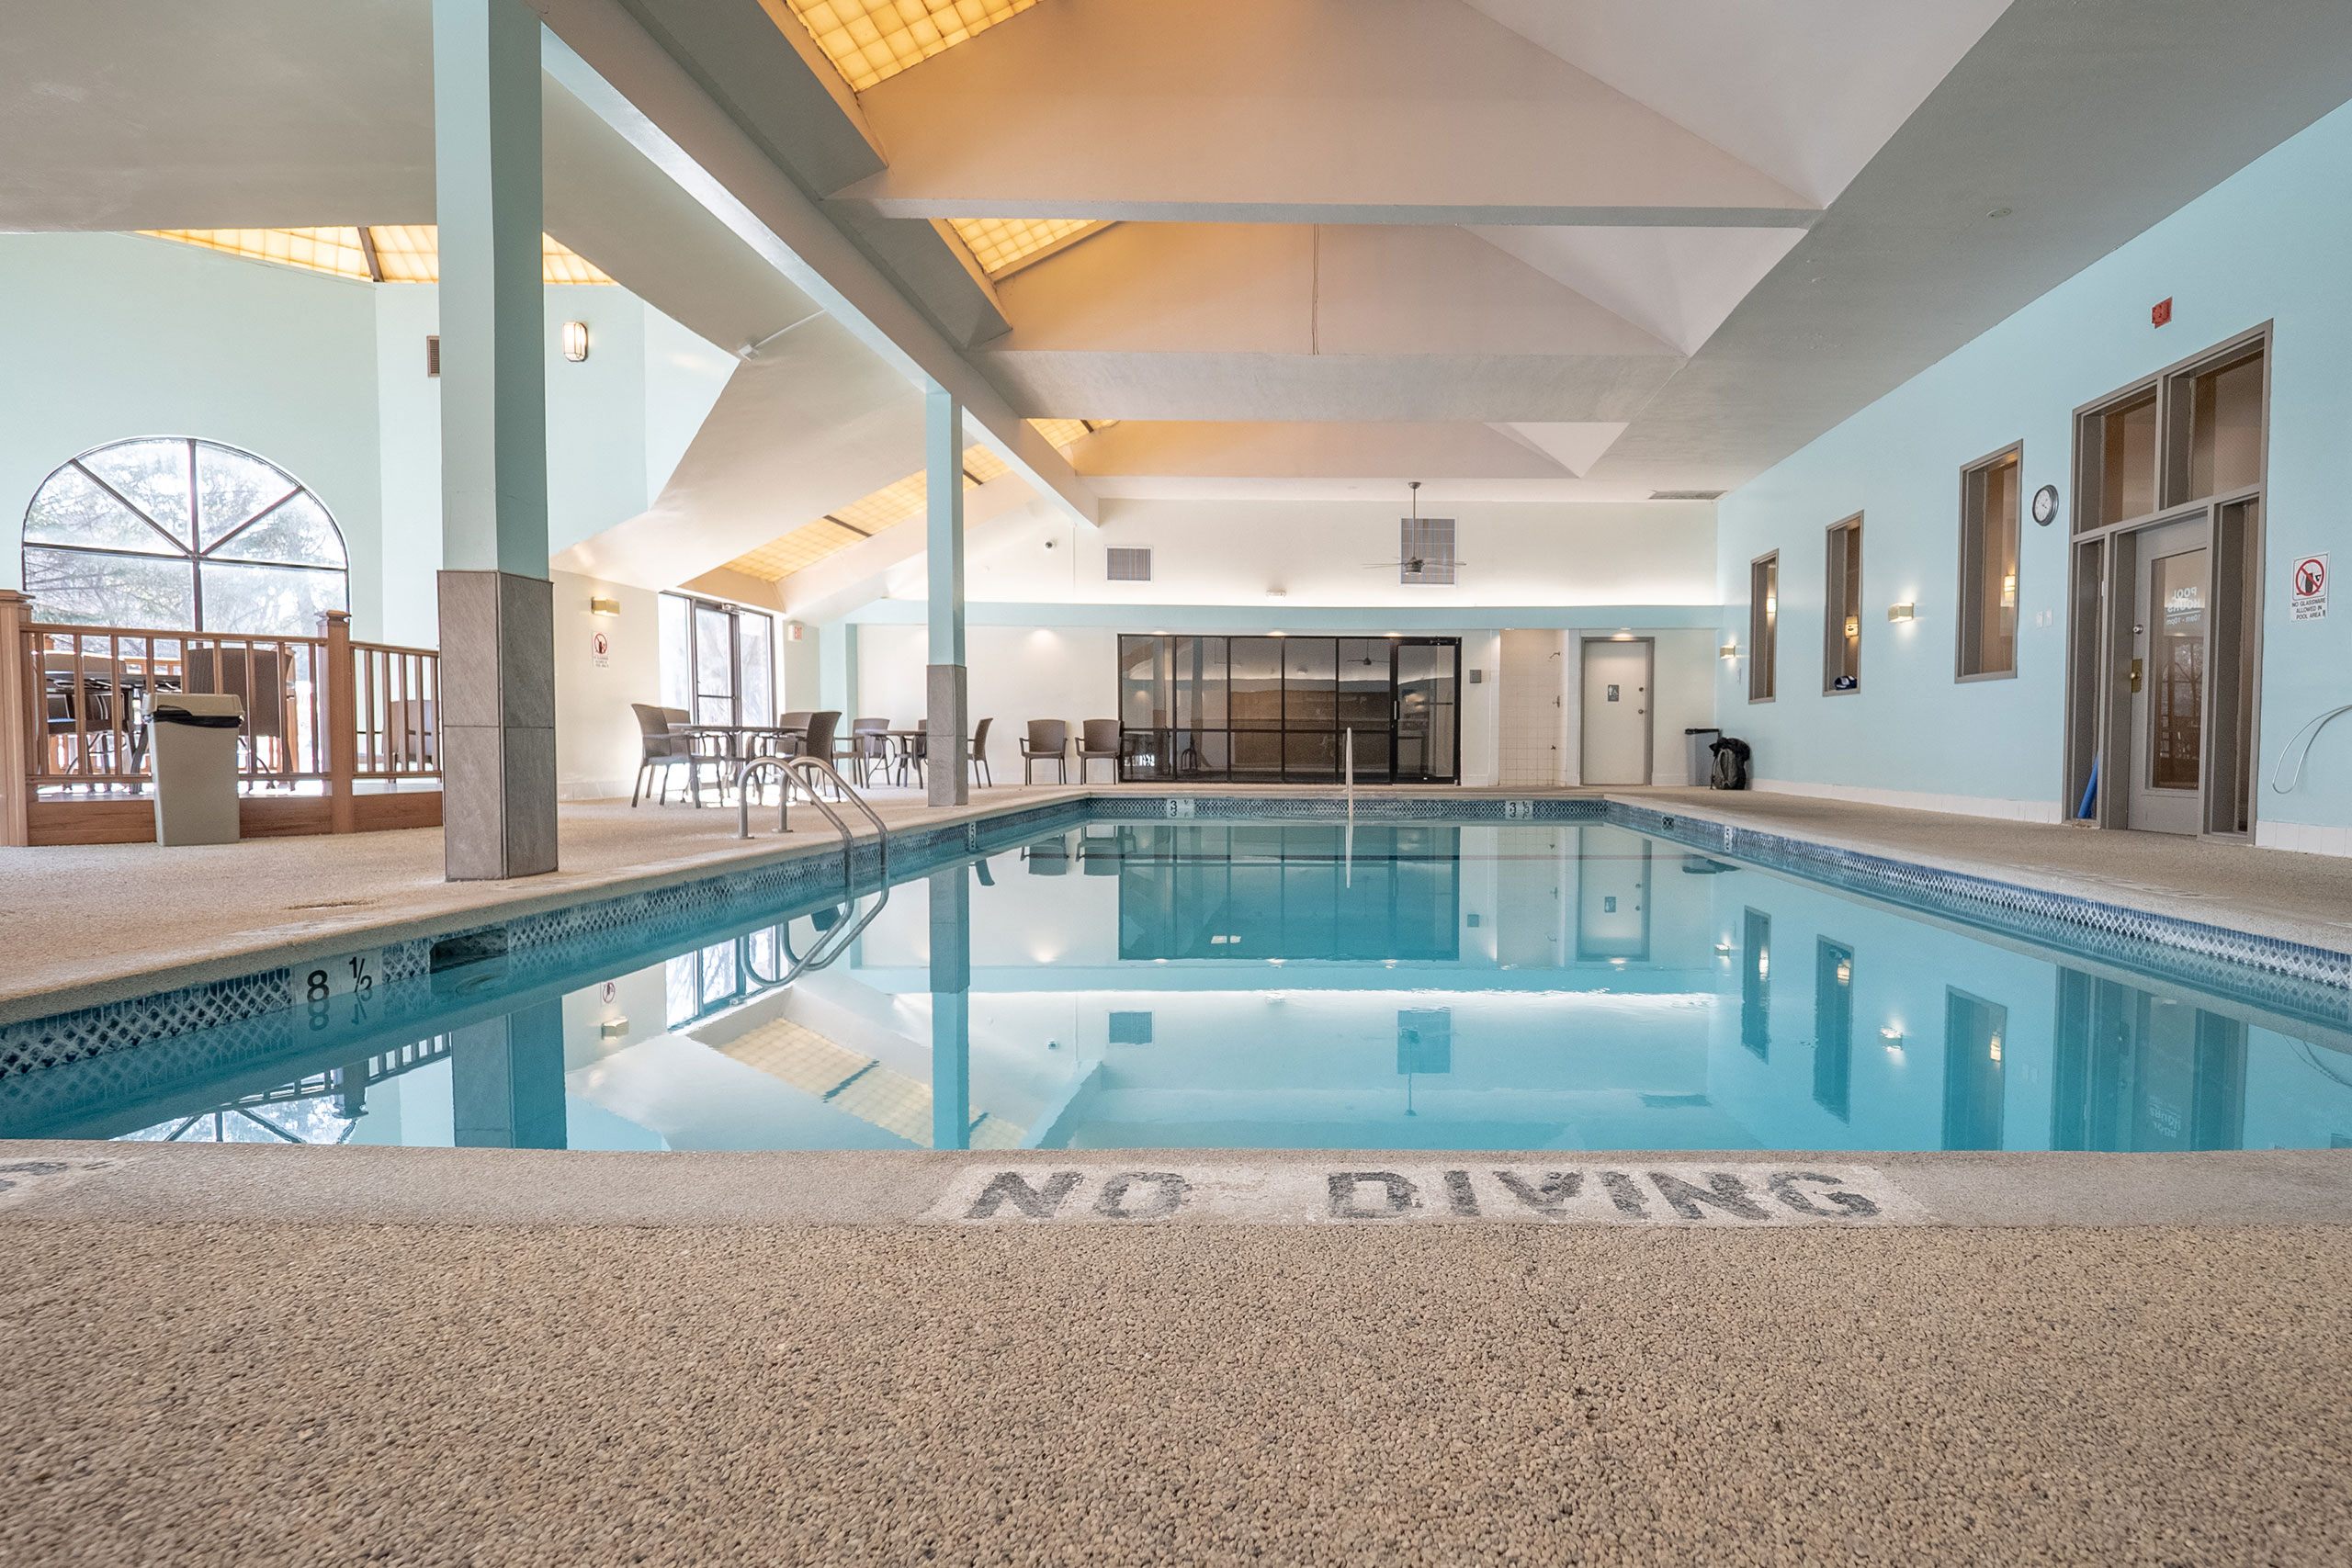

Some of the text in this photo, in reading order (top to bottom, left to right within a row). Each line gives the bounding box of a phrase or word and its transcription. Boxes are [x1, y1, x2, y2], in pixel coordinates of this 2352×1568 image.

[307, 969, 330, 1003] 8
[965, 1170, 1881, 1219] NO DIVING
